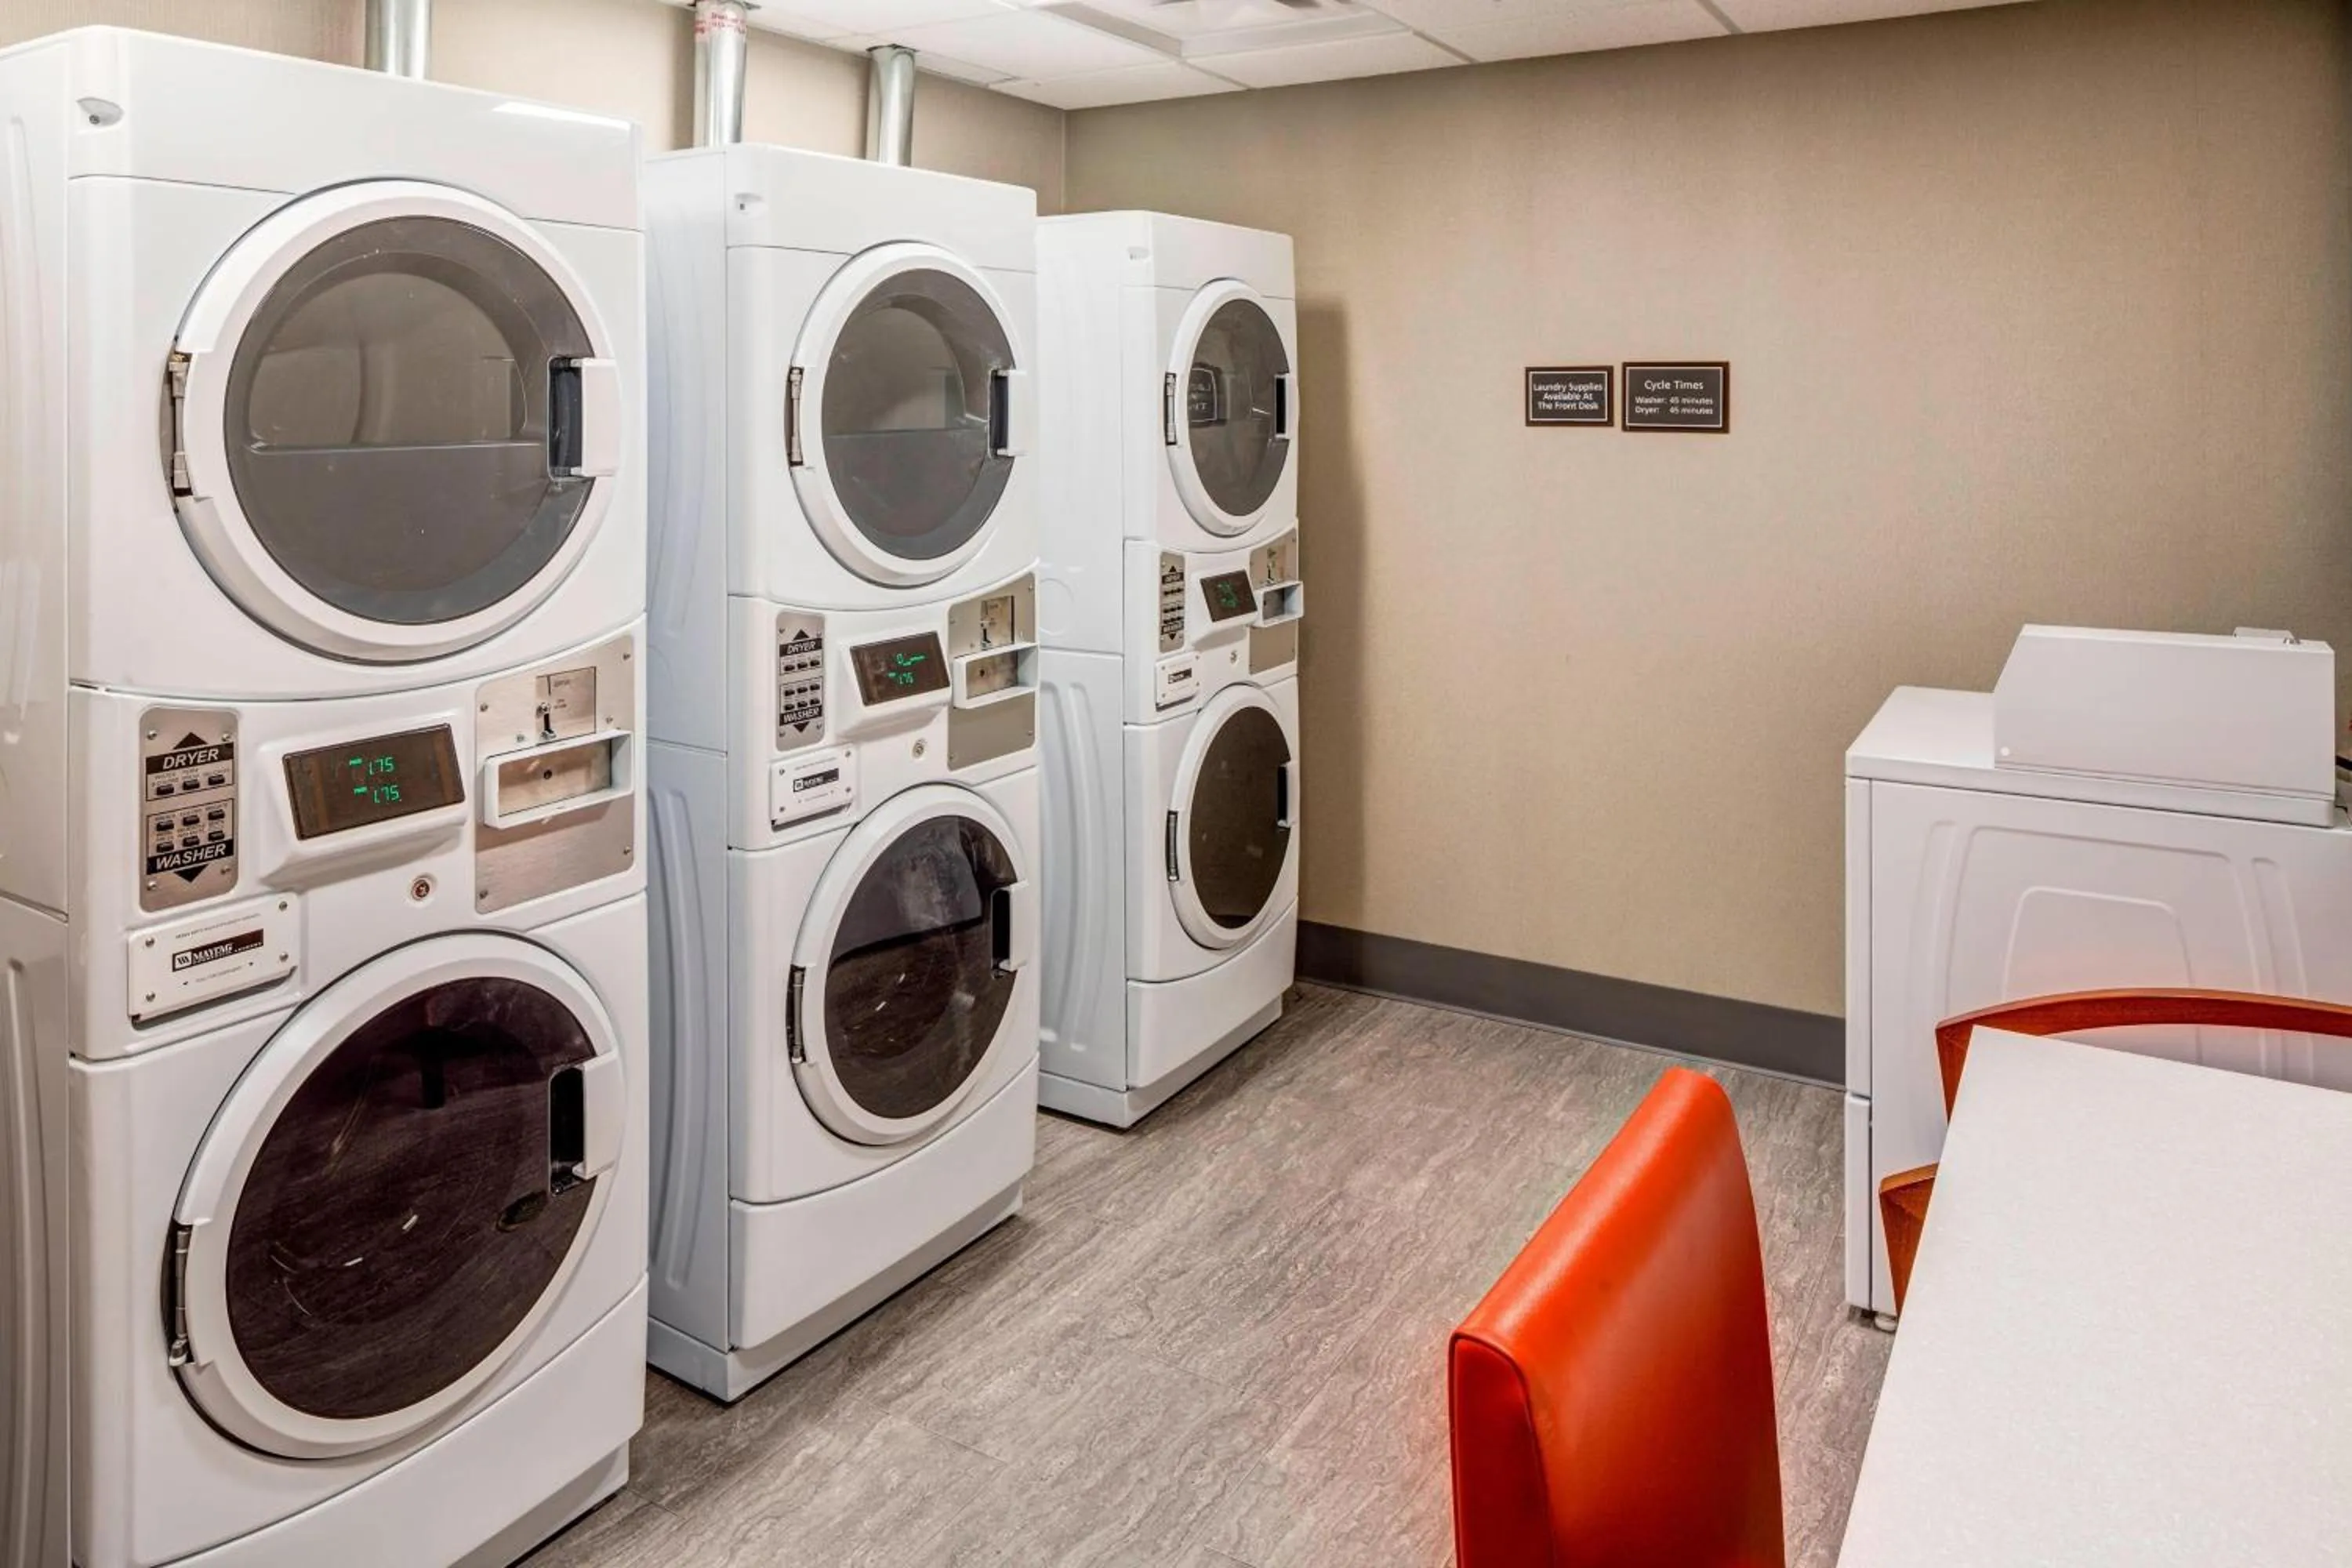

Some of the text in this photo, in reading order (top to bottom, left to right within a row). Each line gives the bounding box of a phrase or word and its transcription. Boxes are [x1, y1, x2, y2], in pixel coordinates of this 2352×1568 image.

[1568, 383, 1602, 392] Supplies
[1644, 379, 1704, 391] Cycle Times
[1635, 406, 1660, 415] Dryer:
[786, 641, 816, 654] DRYER
[783, 708, 819, 723] WASHER
[163, 749, 220, 769] DRYER
[156, 844, 226, 869] WASHER
